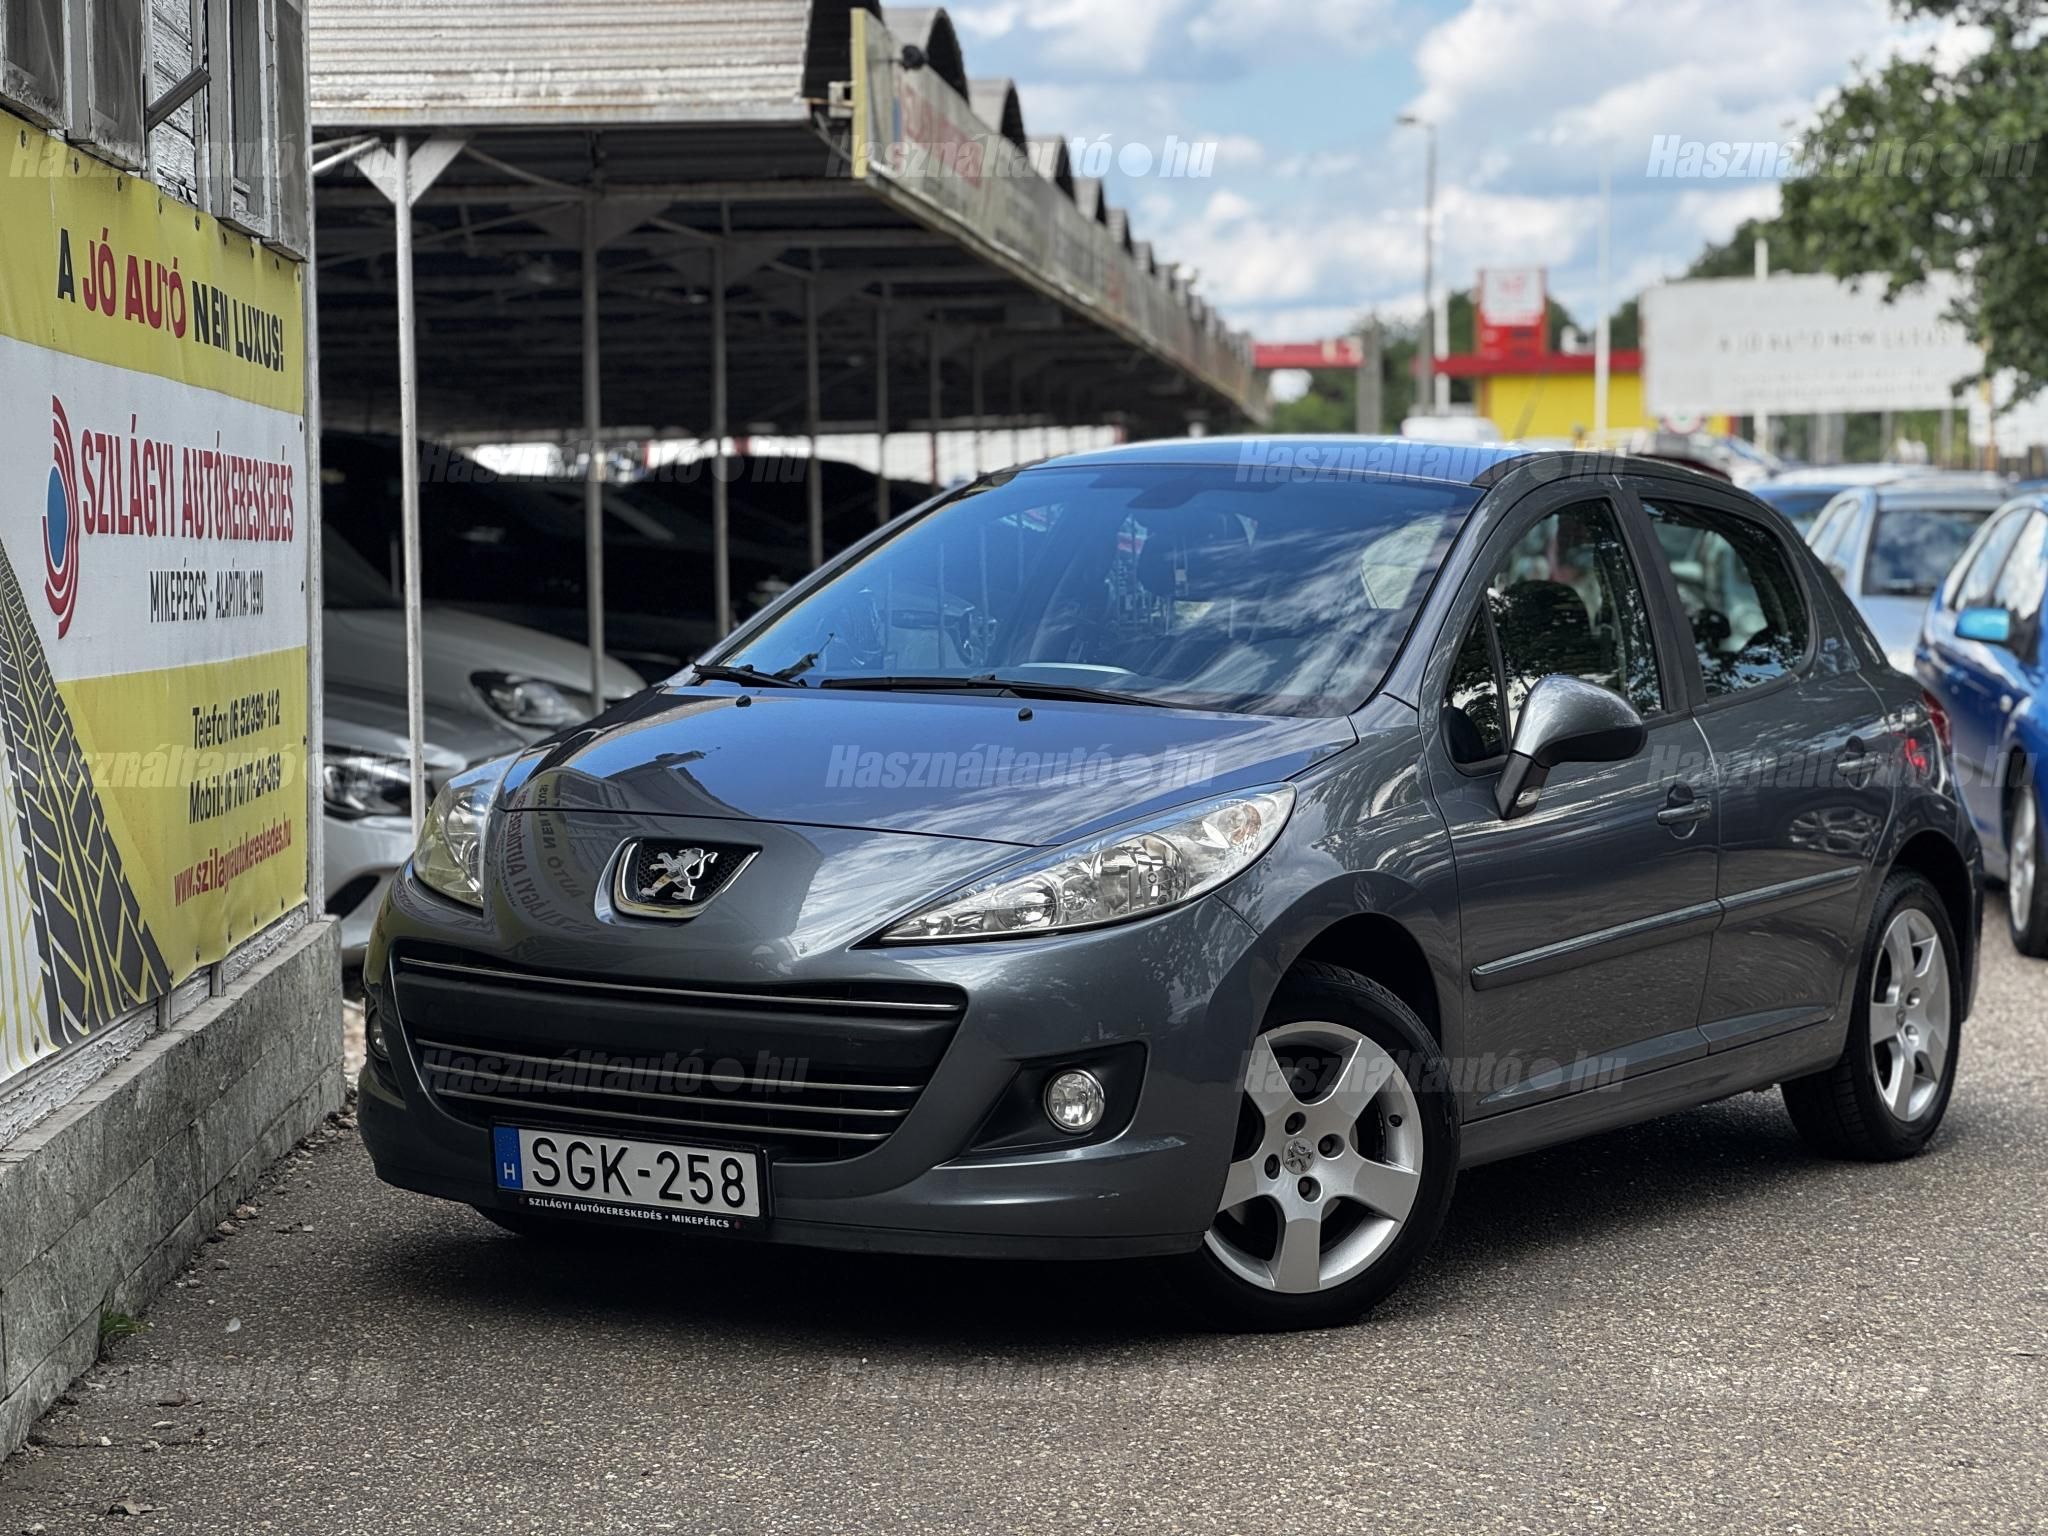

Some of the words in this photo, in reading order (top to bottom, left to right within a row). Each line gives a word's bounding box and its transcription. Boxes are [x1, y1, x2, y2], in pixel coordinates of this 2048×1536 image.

[57, 227, 76, 303] A
[82, 226, 117, 317] JÓ
[124, 256, 187, 338] AUTÓ
[192, 280, 230, 352] NEM
[233, 299, 284, 372] LUXUS!
[81, 413, 175, 538] SZILÁGYI
[182, 430, 294, 543] AUTÓKERESKEDÉS
[150, 557, 207, 623] MIKEPÉRCS
[190, 775, 223, 824] Mobil:
[503, 1162, 516, 1180] H
[532, 1136, 746, 1208] SGK-258
[528, 1197, 572, 1211] SZILÁGYI
[574, 1202, 662, 1221] AUTÓKERESKEDÉS
[671, 1212, 730, 1228] MIKEPÉRCS
